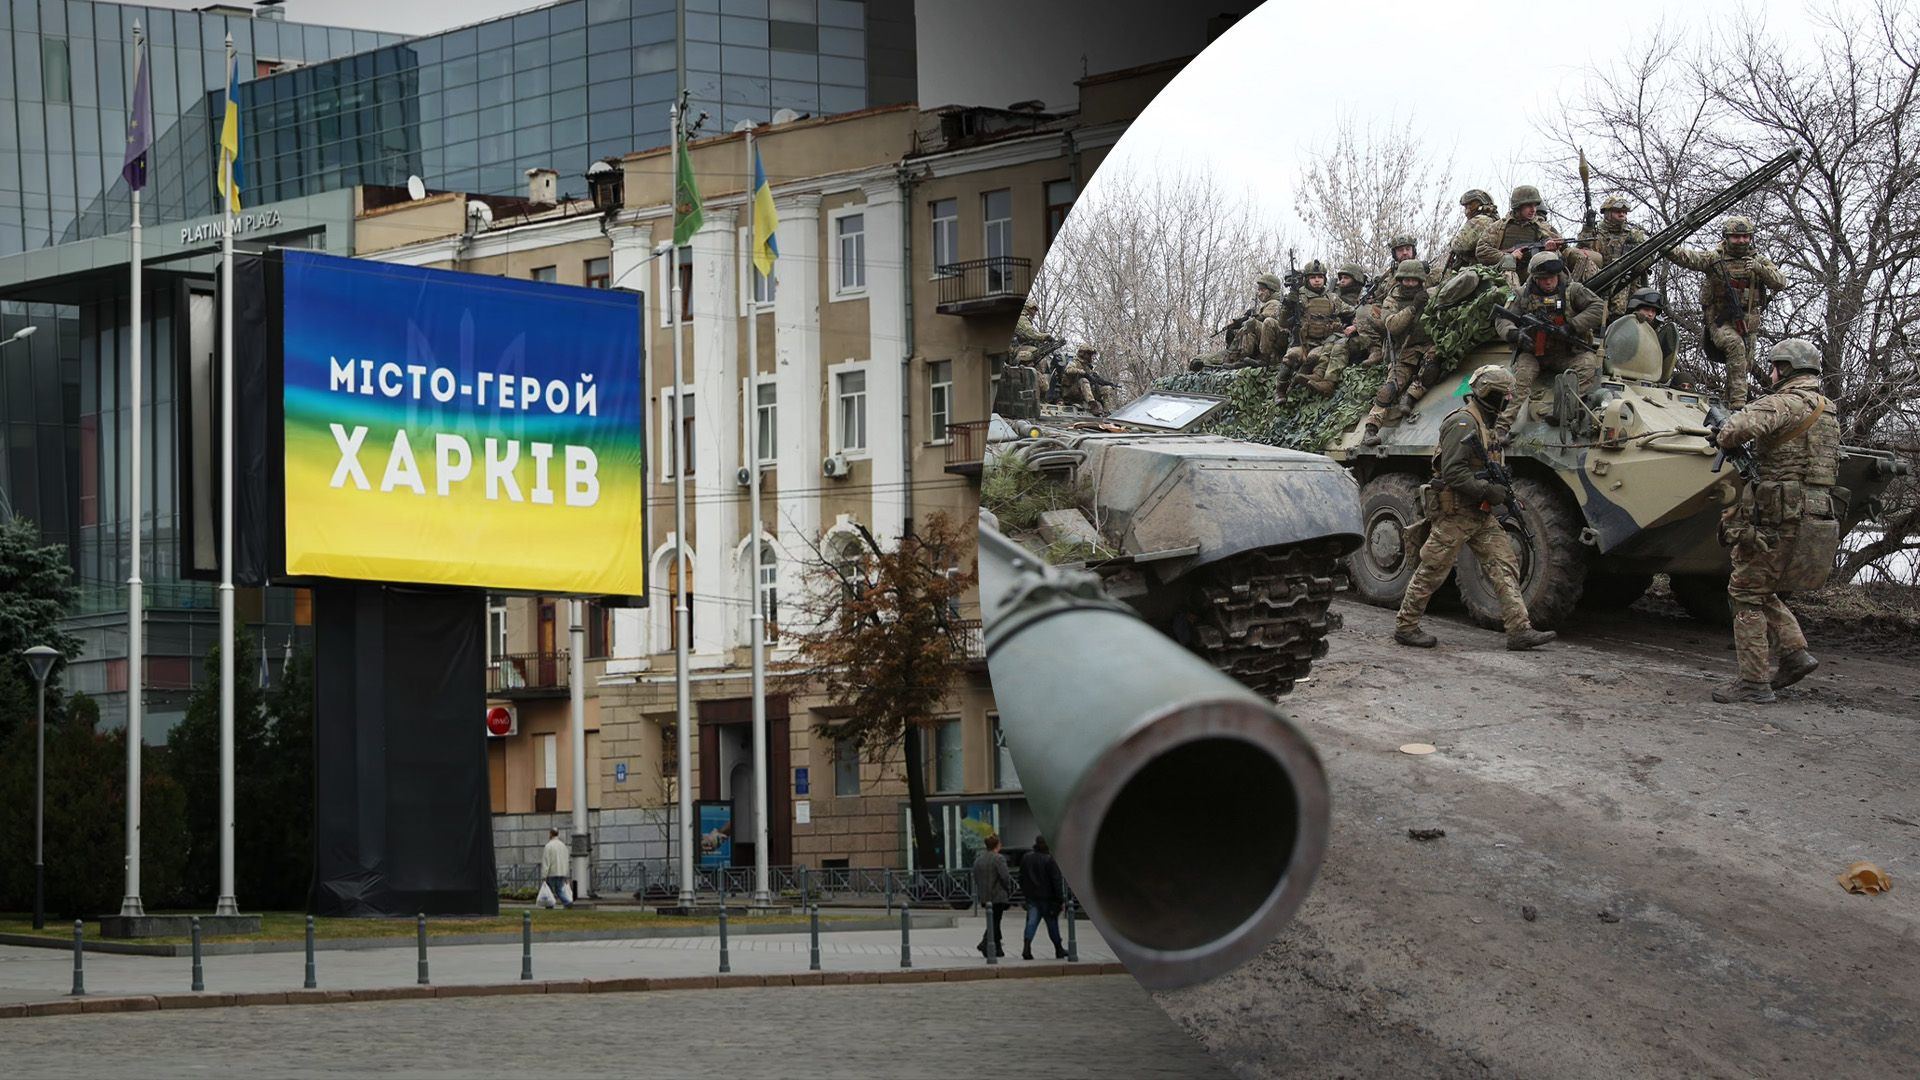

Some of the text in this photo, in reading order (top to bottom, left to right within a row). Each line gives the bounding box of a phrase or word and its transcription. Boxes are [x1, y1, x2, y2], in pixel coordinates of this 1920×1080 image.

[247, 210, 281, 231] PLAZA
[330, 356, 597, 416] МІСТО-ГЕРОЙ
[330, 424, 599, 506] ХАРКІВ
